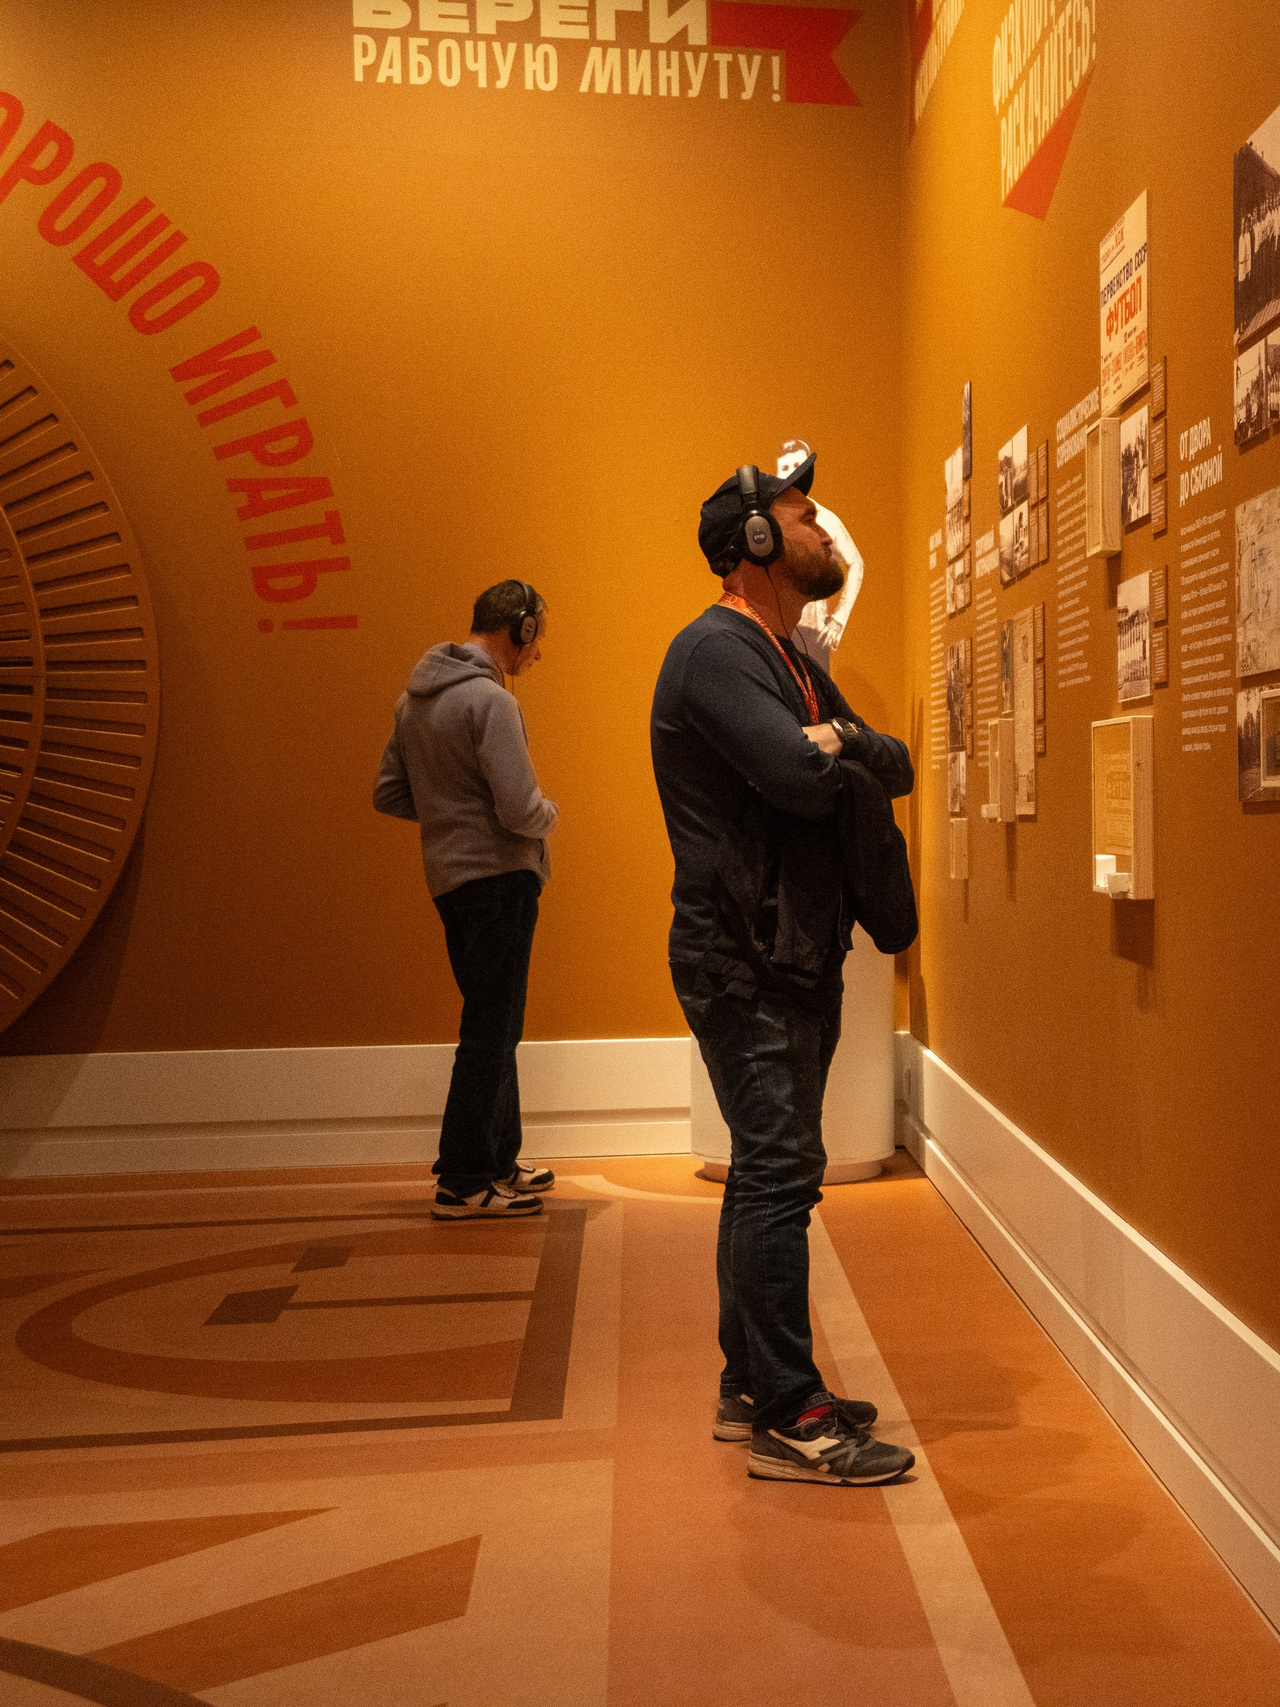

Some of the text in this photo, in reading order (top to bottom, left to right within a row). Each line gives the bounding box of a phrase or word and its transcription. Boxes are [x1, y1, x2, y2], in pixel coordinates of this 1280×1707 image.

[352, 0, 709, 46] БЕРЕГИ
[352, 34, 782, 102] РАБОЧУЮ МИНУТУ!
[1105, 274, 1143, 342] ФУТБОЛ
[1179, 430, 1188, 461] ОТ
[1189, 416, 1212, 462] ДВОРА
[168, 325, 359, 634] ИГРАТЬ!
[1179, 471, 1189, 508] ДО
[1190, 444, 1223, 497] СБОРНОЙ
